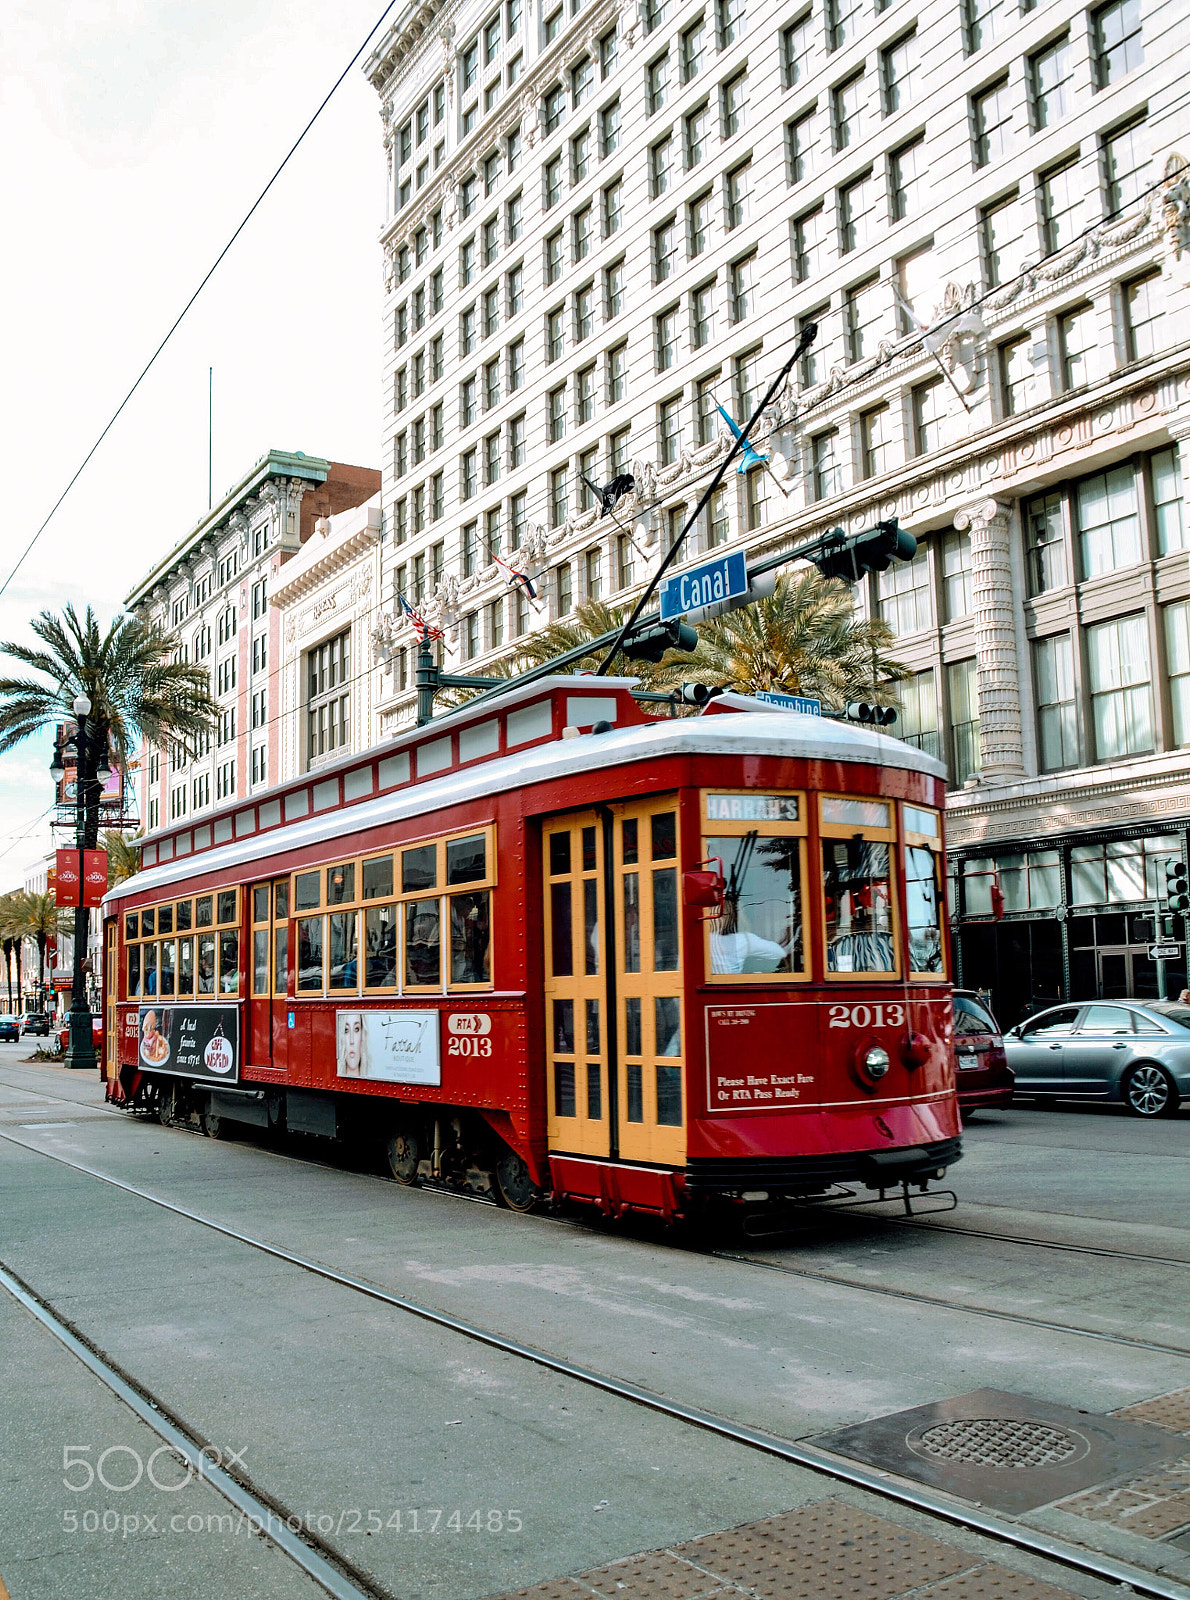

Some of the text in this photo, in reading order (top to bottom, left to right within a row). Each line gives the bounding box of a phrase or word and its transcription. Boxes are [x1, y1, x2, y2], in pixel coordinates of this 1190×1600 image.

[680, 559, 730, 611] Canal
[456, 1018, 472, 1030] RTA
[829, 1004, 905, 1028] 2013
[448, 1037, 493, 1057] 2013
[717, 1073, 815, 1087] Please Have Exact Fare
[717, 1087, 801, 1100] Or RTA Pass Ready
